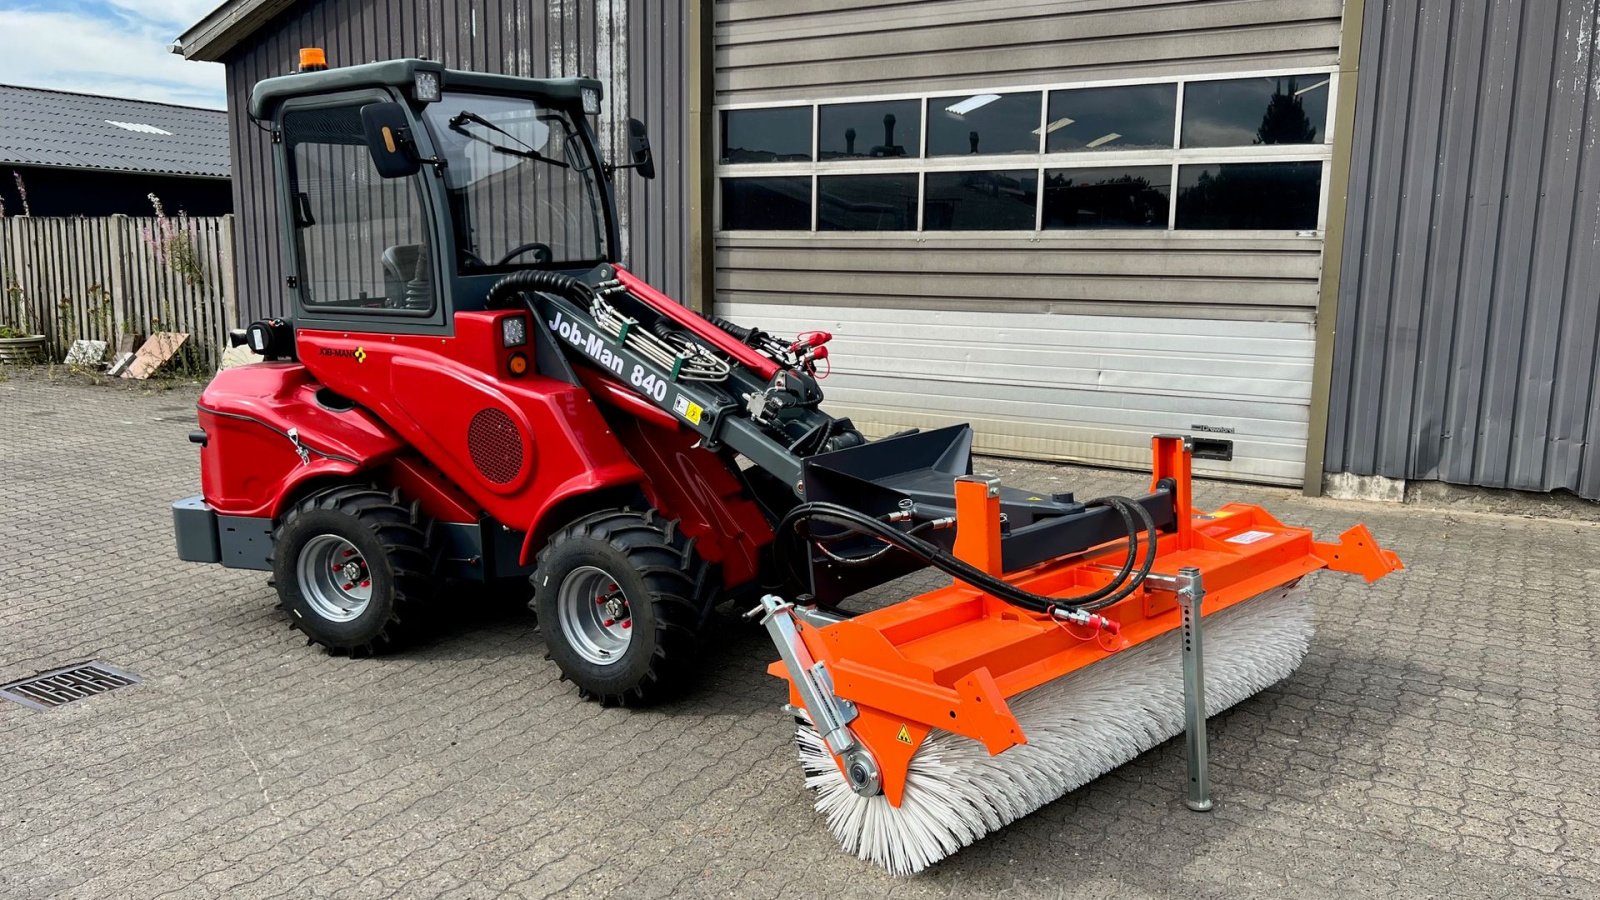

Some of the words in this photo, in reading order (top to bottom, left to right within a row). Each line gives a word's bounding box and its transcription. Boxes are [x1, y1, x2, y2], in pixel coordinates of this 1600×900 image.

[319, 346, 353, 358] JOB-MAN
[548, 312, 624, 375] Job-Man
[630, 364, 667, 402] 840
